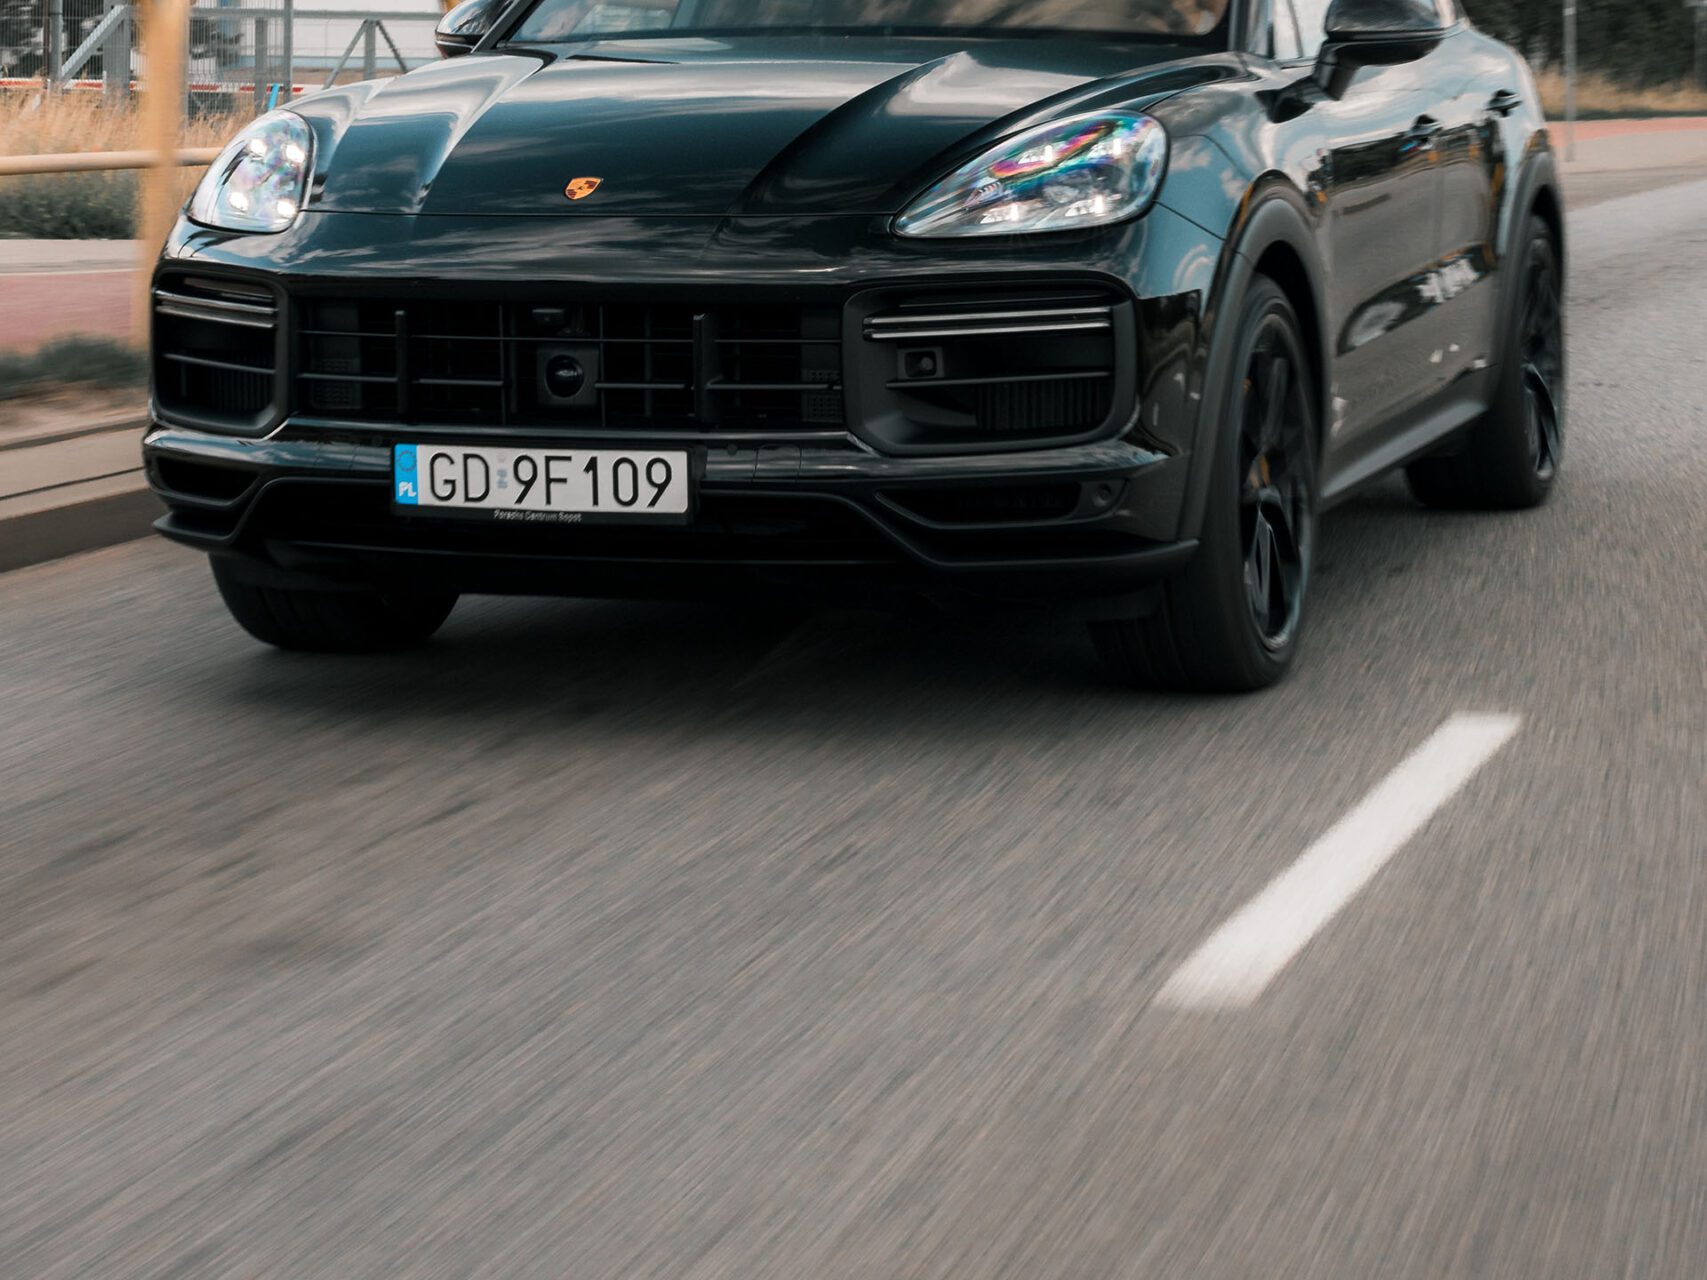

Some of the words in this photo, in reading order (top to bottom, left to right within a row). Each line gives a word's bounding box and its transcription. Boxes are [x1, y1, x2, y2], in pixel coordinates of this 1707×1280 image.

[399, 481, 416, 497] PL
[429, 452, 489, 502] GD
[513, 455, 672, 507] 9F109
